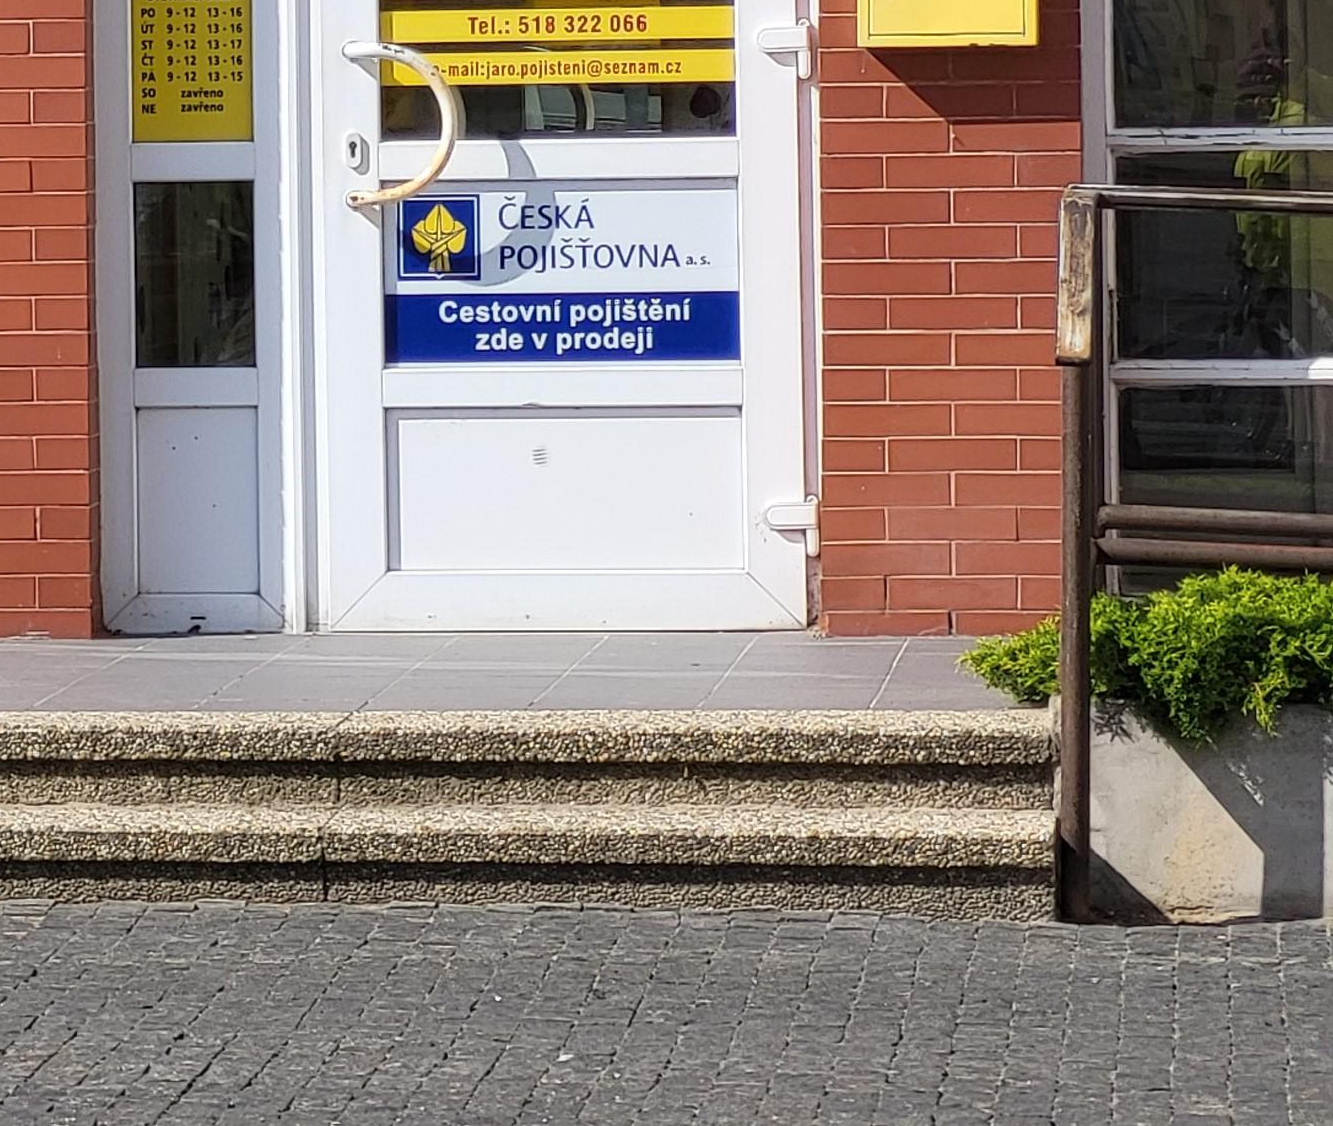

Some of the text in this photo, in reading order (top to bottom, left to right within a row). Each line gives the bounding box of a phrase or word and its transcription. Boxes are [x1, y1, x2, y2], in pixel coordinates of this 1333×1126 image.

[140, 6, 243, 18] PO 9 12 13 16
[140, 21, 243, 34] ÚT 9 12 13 16
[468, 14, 648, 36] Tel.: 518 322 066
[141, 38, 243, 50] ST 9 12 13 17
[141, 52, 243, 66] ČT 9 12 13 16
[141, 68, 243, 82] PÁ 9 12 13 15
[141, 86, 224, 99] SO zavřeno
[141, 100, 224, 114] NE zavřeno
[498, 196, 595, 231] ČESKÁ
[498, 237, 681, 274] POJIŠŤOVNA
[438, 298, 691, 330] Cestovní pojištění
[475, 326, 654, 355] zde v prodeji
